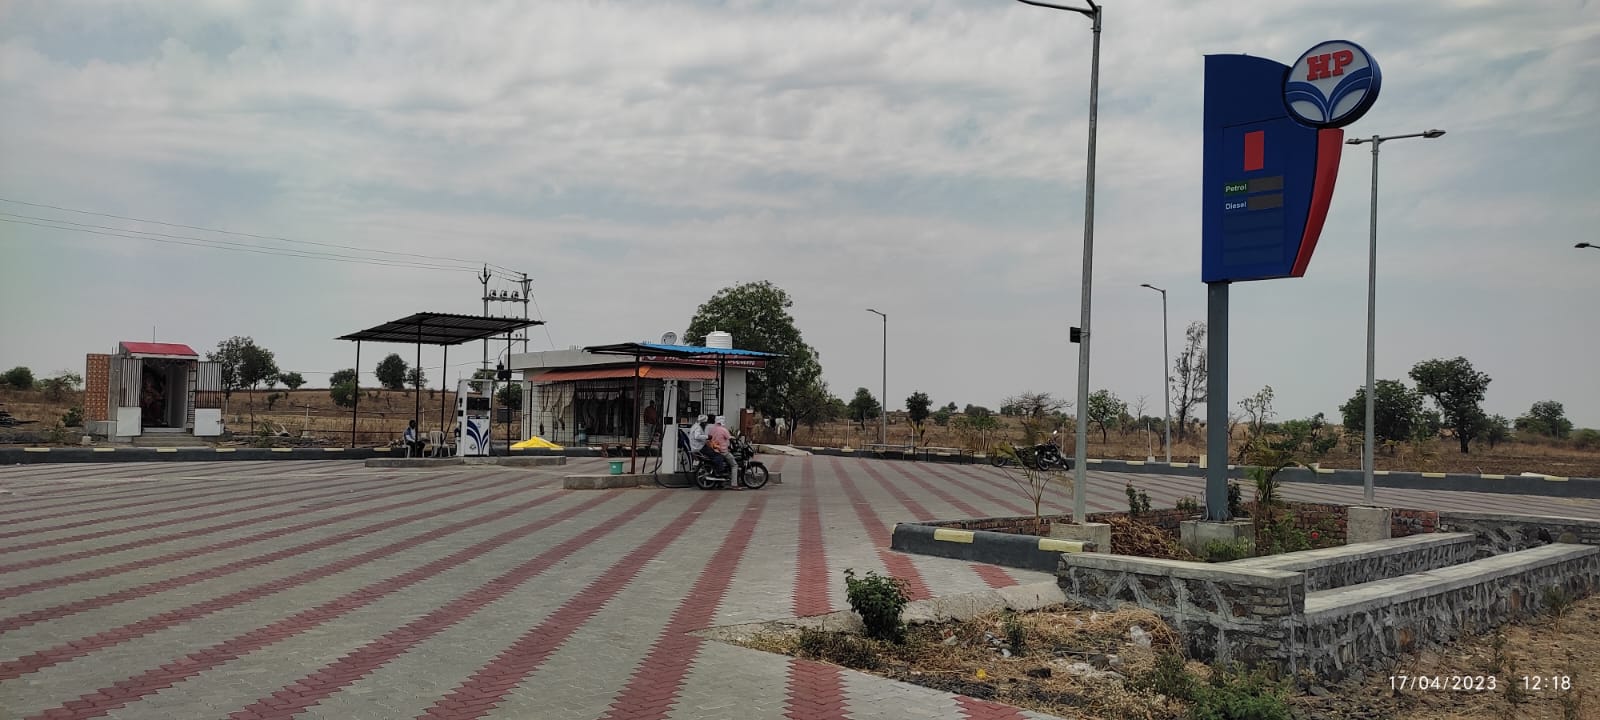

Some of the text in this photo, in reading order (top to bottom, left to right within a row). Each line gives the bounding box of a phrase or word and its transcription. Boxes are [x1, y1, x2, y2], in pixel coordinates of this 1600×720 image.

[1307, 50, 1353, 81] HP
[1225, 184, 1247, 193] Petrol
[1225, 201, 1247, 210] Diesel
